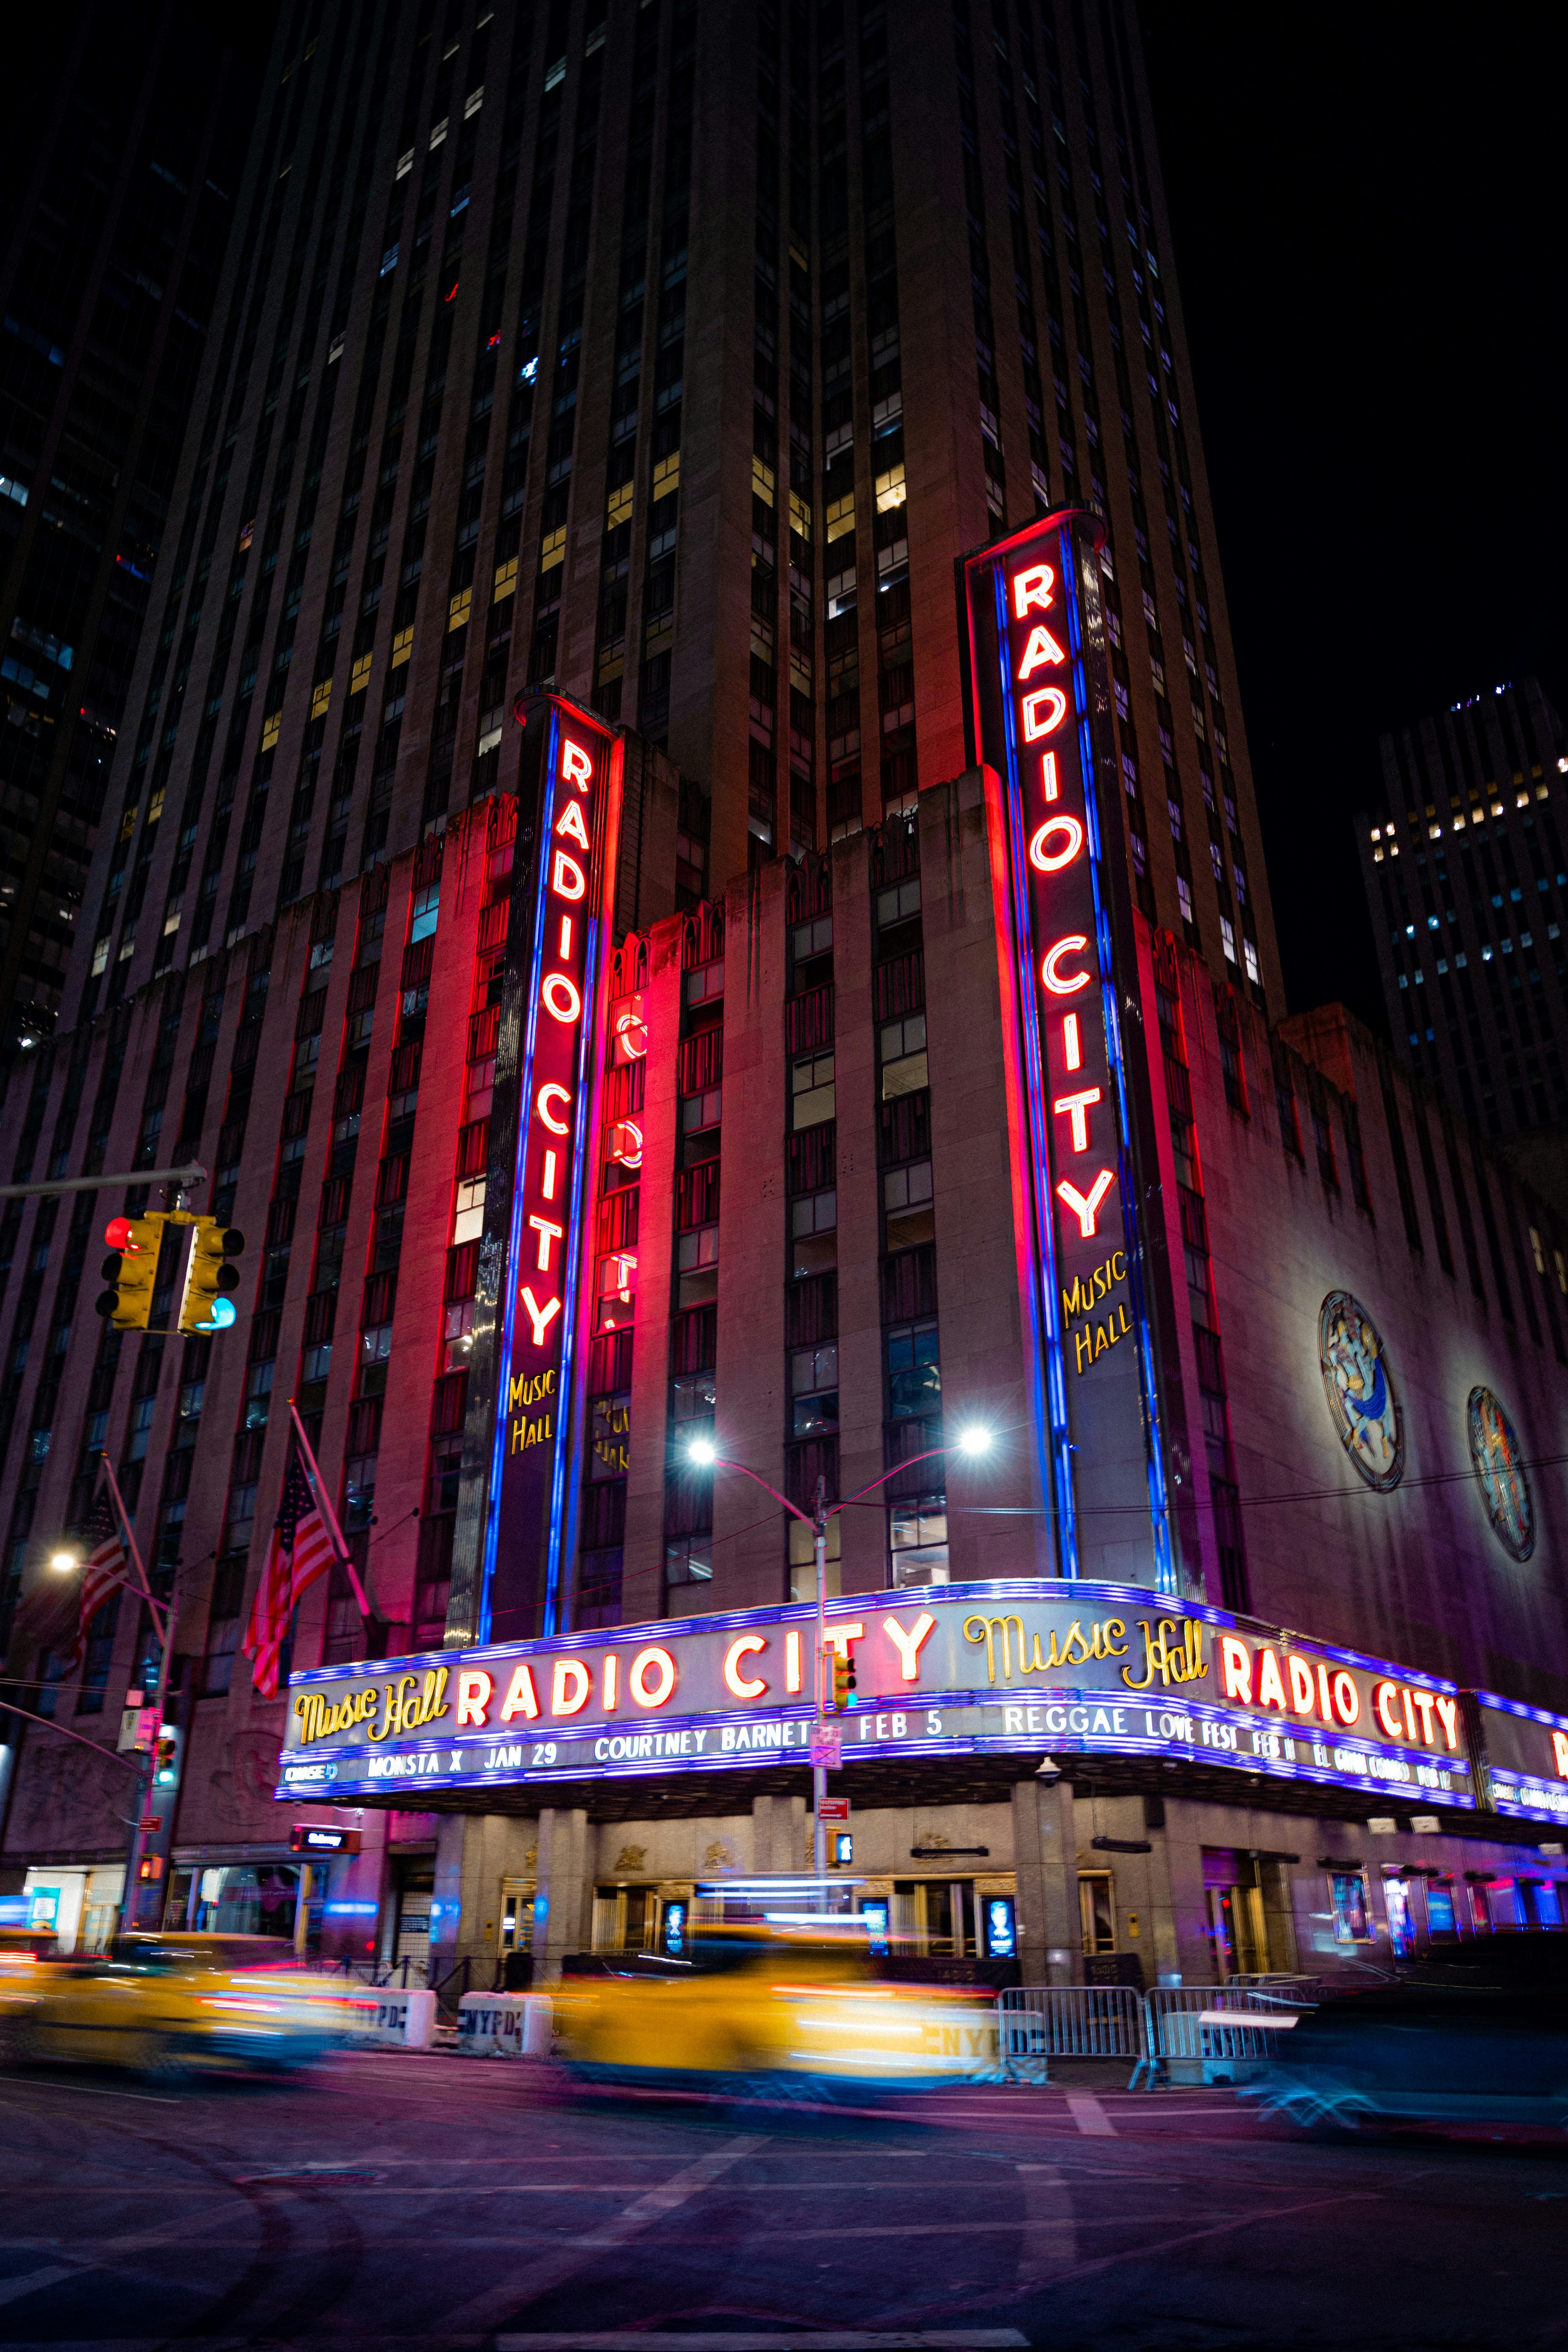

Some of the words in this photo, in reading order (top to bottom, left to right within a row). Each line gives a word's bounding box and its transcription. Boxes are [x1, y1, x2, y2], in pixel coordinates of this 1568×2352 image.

[1012, 564, 1084, 872] RADIO
[542, 738, 593, 1024] RADIO
[1041, 934, 1116, 1238] CITY
[521, 1082, 572, 1346] CITY
[1062, 1251, 1128, 1329] MUSIC
[1074, 1303, 1133, 1375] HALL
[508, 1369, 556, 1413] MUSIC
[511, 1413, 553, 1455] HALL
[456, 1646, 675, 1727] RADIO
[723, 1611, 936, 1699] CITY
[963, 1614, 1129, 1683] Music
[1122, 1618, 1208, 1689] Hall
[294, 1688, 377, 1745] Music
[367, 1666, 449, 1742] Hall
[1005, 1706, 1128, 1734] REGGAE
[1146, 1711, 1195, 1743] LOVE
[1202, 1721, 1238, 1750] FEST
[1221, 1635, 1360, 1725] RADIO
[1376, 1681, 1457, 1750] CITY
[368, 1754, 440, 1778] MONSTA
[449, 1751, 463, 1772] X
[484, 1745, 522, 1769] JAN
[533, 1743, 558, 1765] 29
[595, 1730, 707, 1761] COURTNEY
[721, 1721, 818, 1751] BARNET
[860, 1713, 908, 1740] FEB
[926, 1710, 942, 1735] 5
